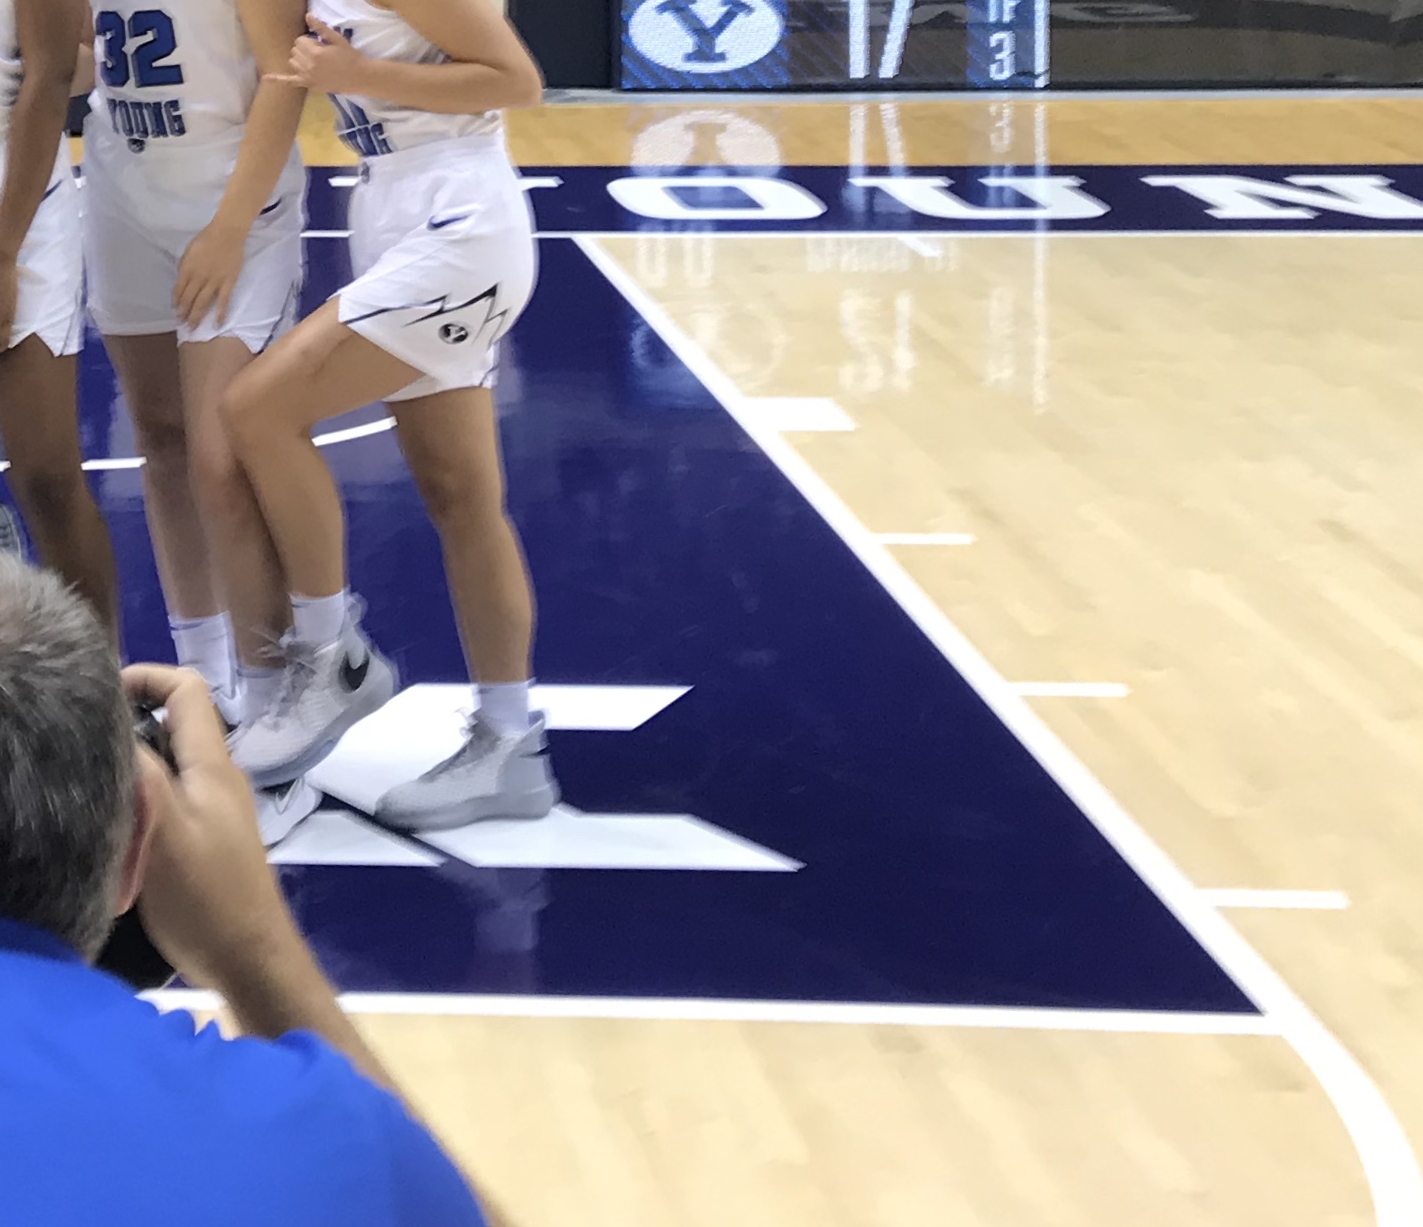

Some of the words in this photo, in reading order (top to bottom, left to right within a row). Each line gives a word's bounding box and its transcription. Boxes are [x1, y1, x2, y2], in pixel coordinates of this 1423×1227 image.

[95, 9, 184, 88] 32
[988, 31, 1016, 81] 3
[107, 98, 186, 138] YOUNG
